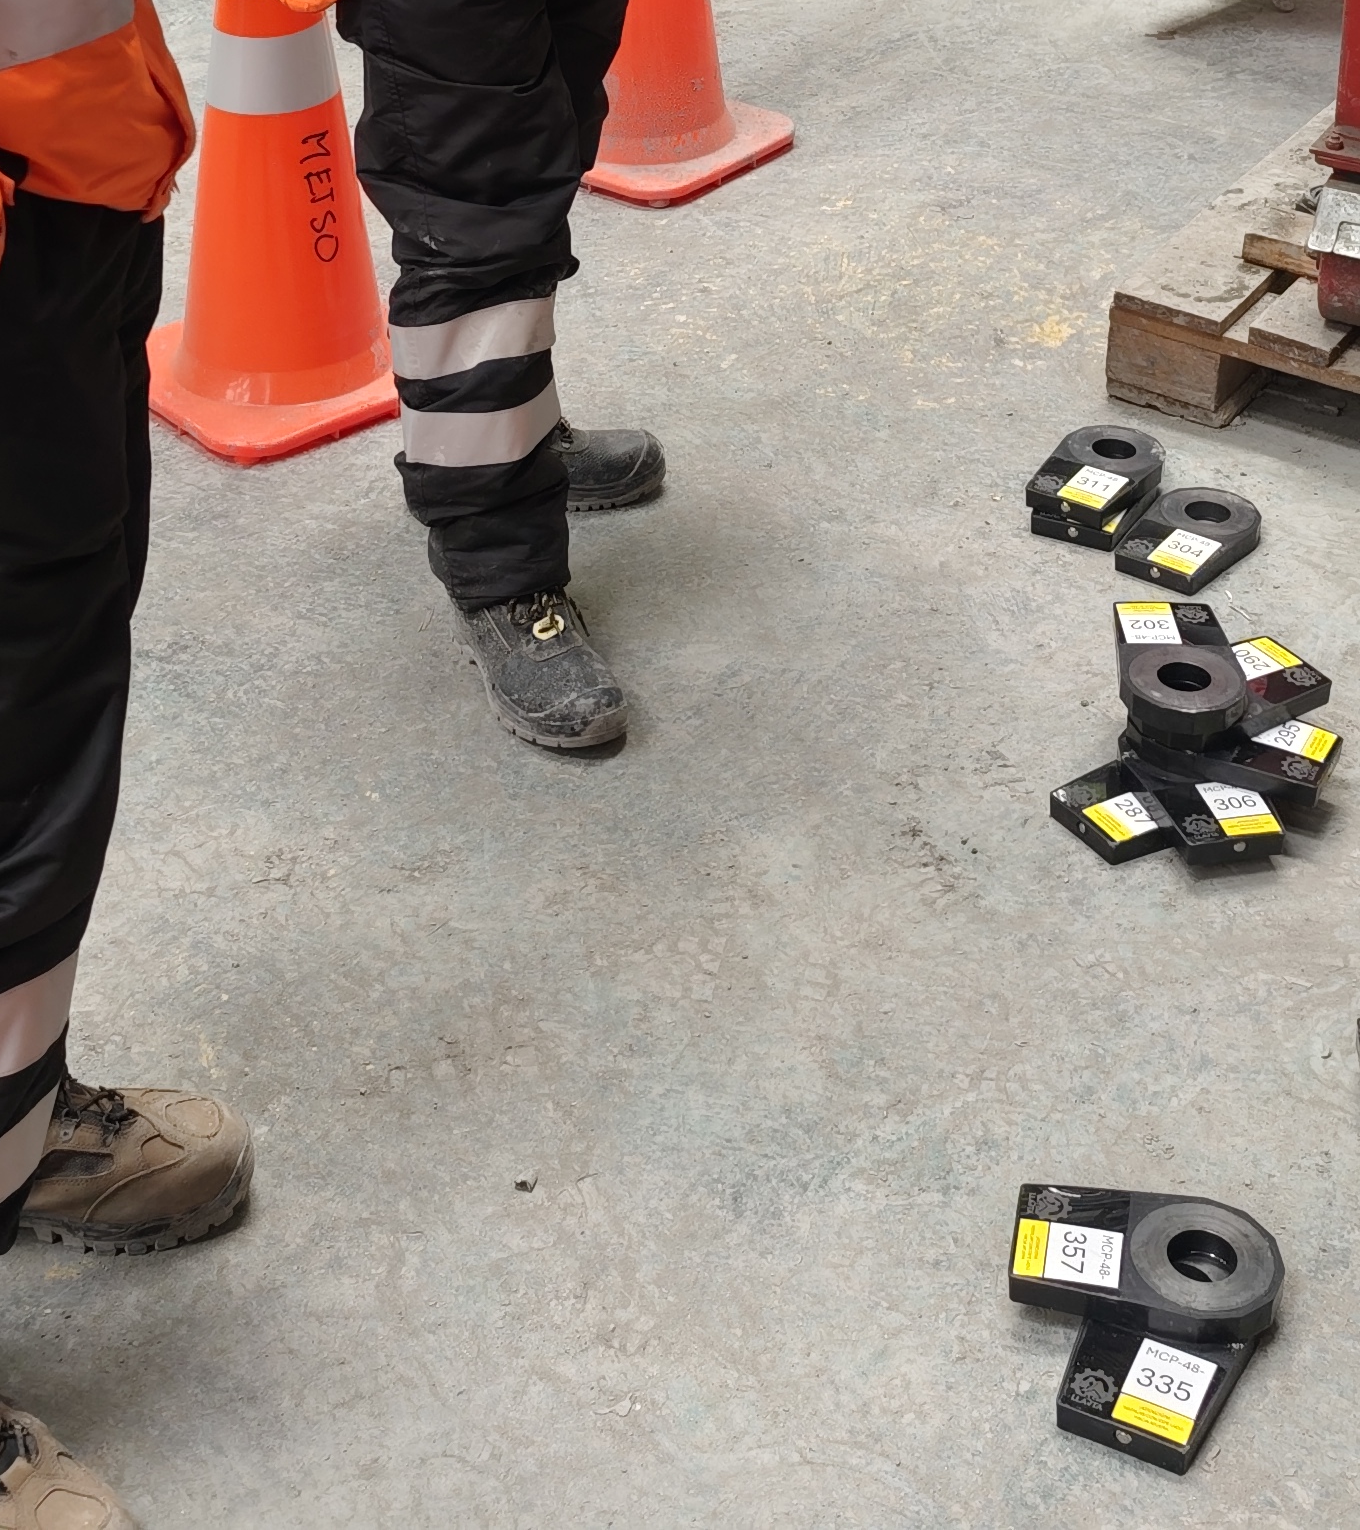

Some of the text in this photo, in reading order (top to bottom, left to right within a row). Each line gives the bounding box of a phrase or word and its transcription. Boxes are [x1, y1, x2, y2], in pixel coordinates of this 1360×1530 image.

[299, 130, 340, 263] METSO
[1076, 476, 1111, 492] 311
[1167, 540, 1204, 559] 304
[1130, 619, 1170, 630] 302
[1235, 648, 1272, 672] 290
[1273, 723, 1301, 748] 295
[1212, 795, 1258, 811] 306
[1060, 1230, 1088, 1275] 357
[1136, 1367, 1194, 1402] 335
